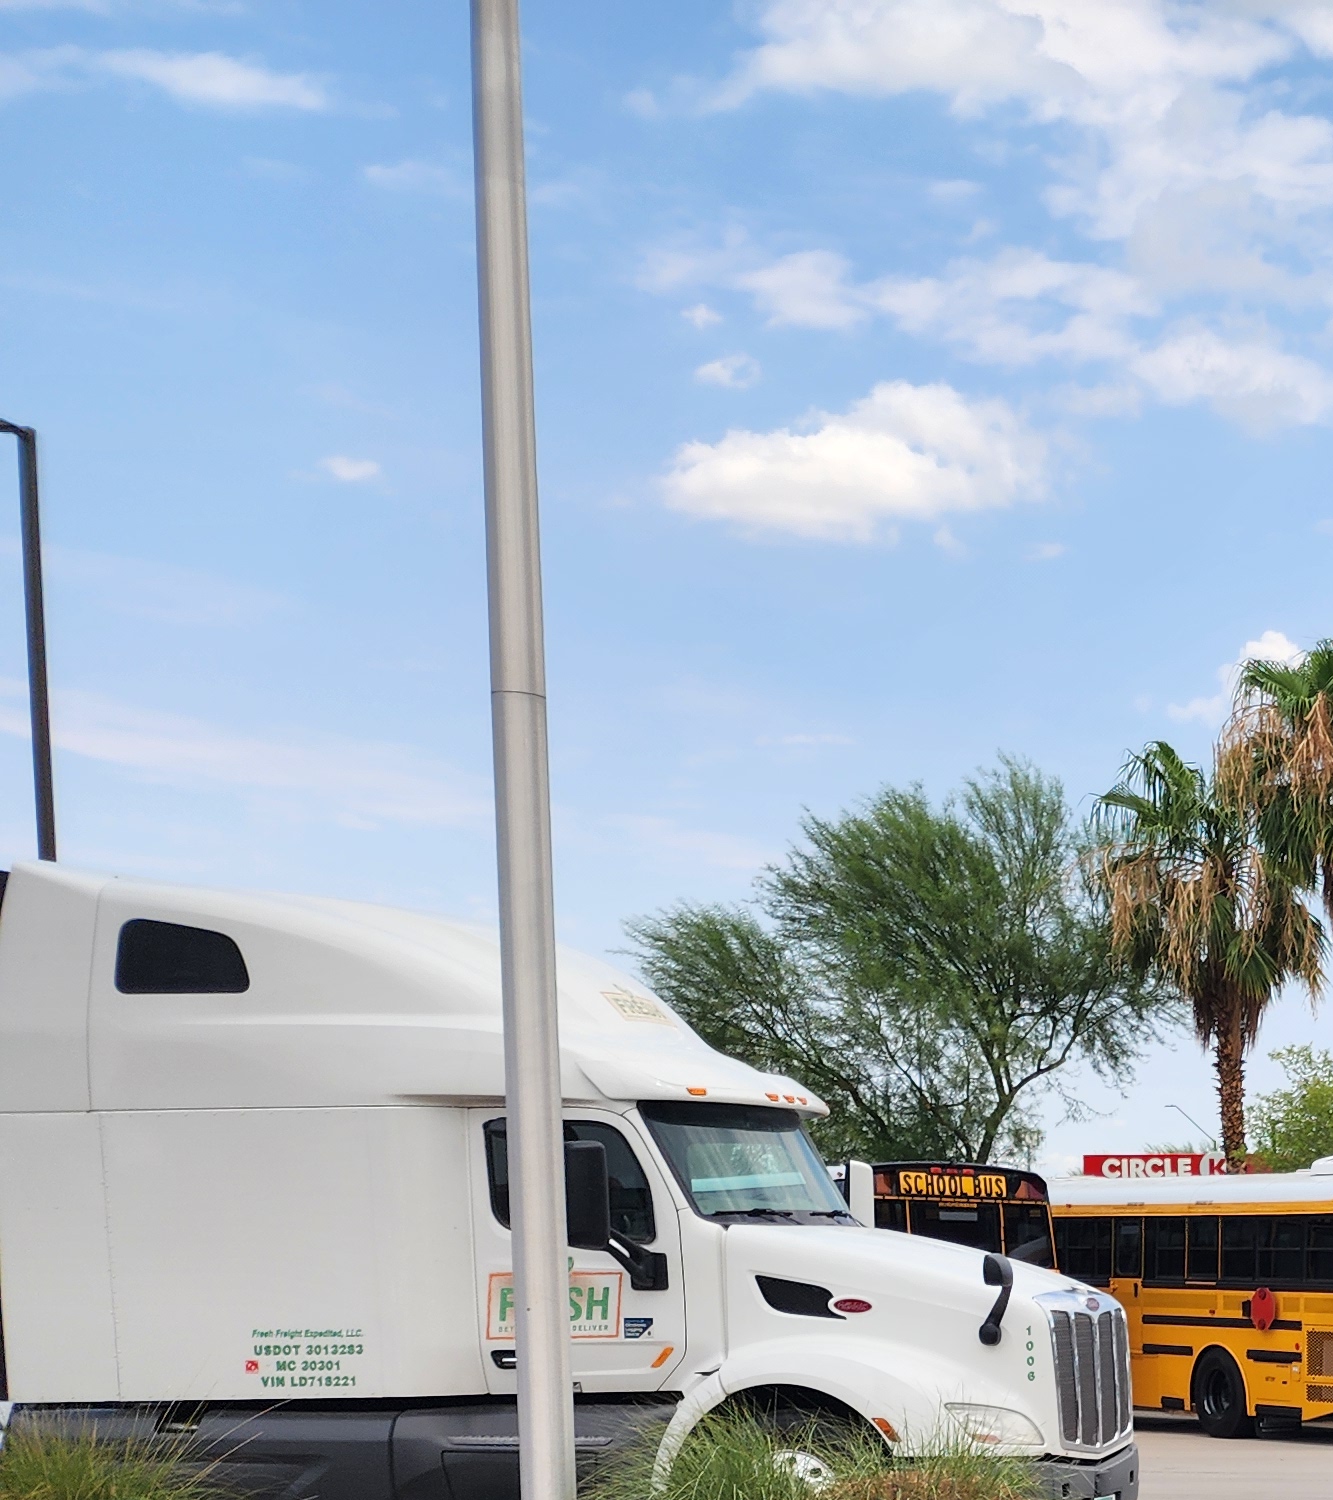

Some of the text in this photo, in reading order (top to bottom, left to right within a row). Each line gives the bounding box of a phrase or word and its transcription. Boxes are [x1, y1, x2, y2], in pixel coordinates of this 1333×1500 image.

[1102, 1157, 1226, 1178] CIRCLE K
[902, 1173, 1004, 1197] SCHOOL BUS
[499, 1287, 610, 1321] FSH
[572, 1324, 609, 1332] DELIVER
[254, 1345, 301, 1356] USDOT
[1025, 1325, 1035, 1382] 1006
[276, 1360, 297, 1371] MC
[261, 1376, 286, 1387] VIN
